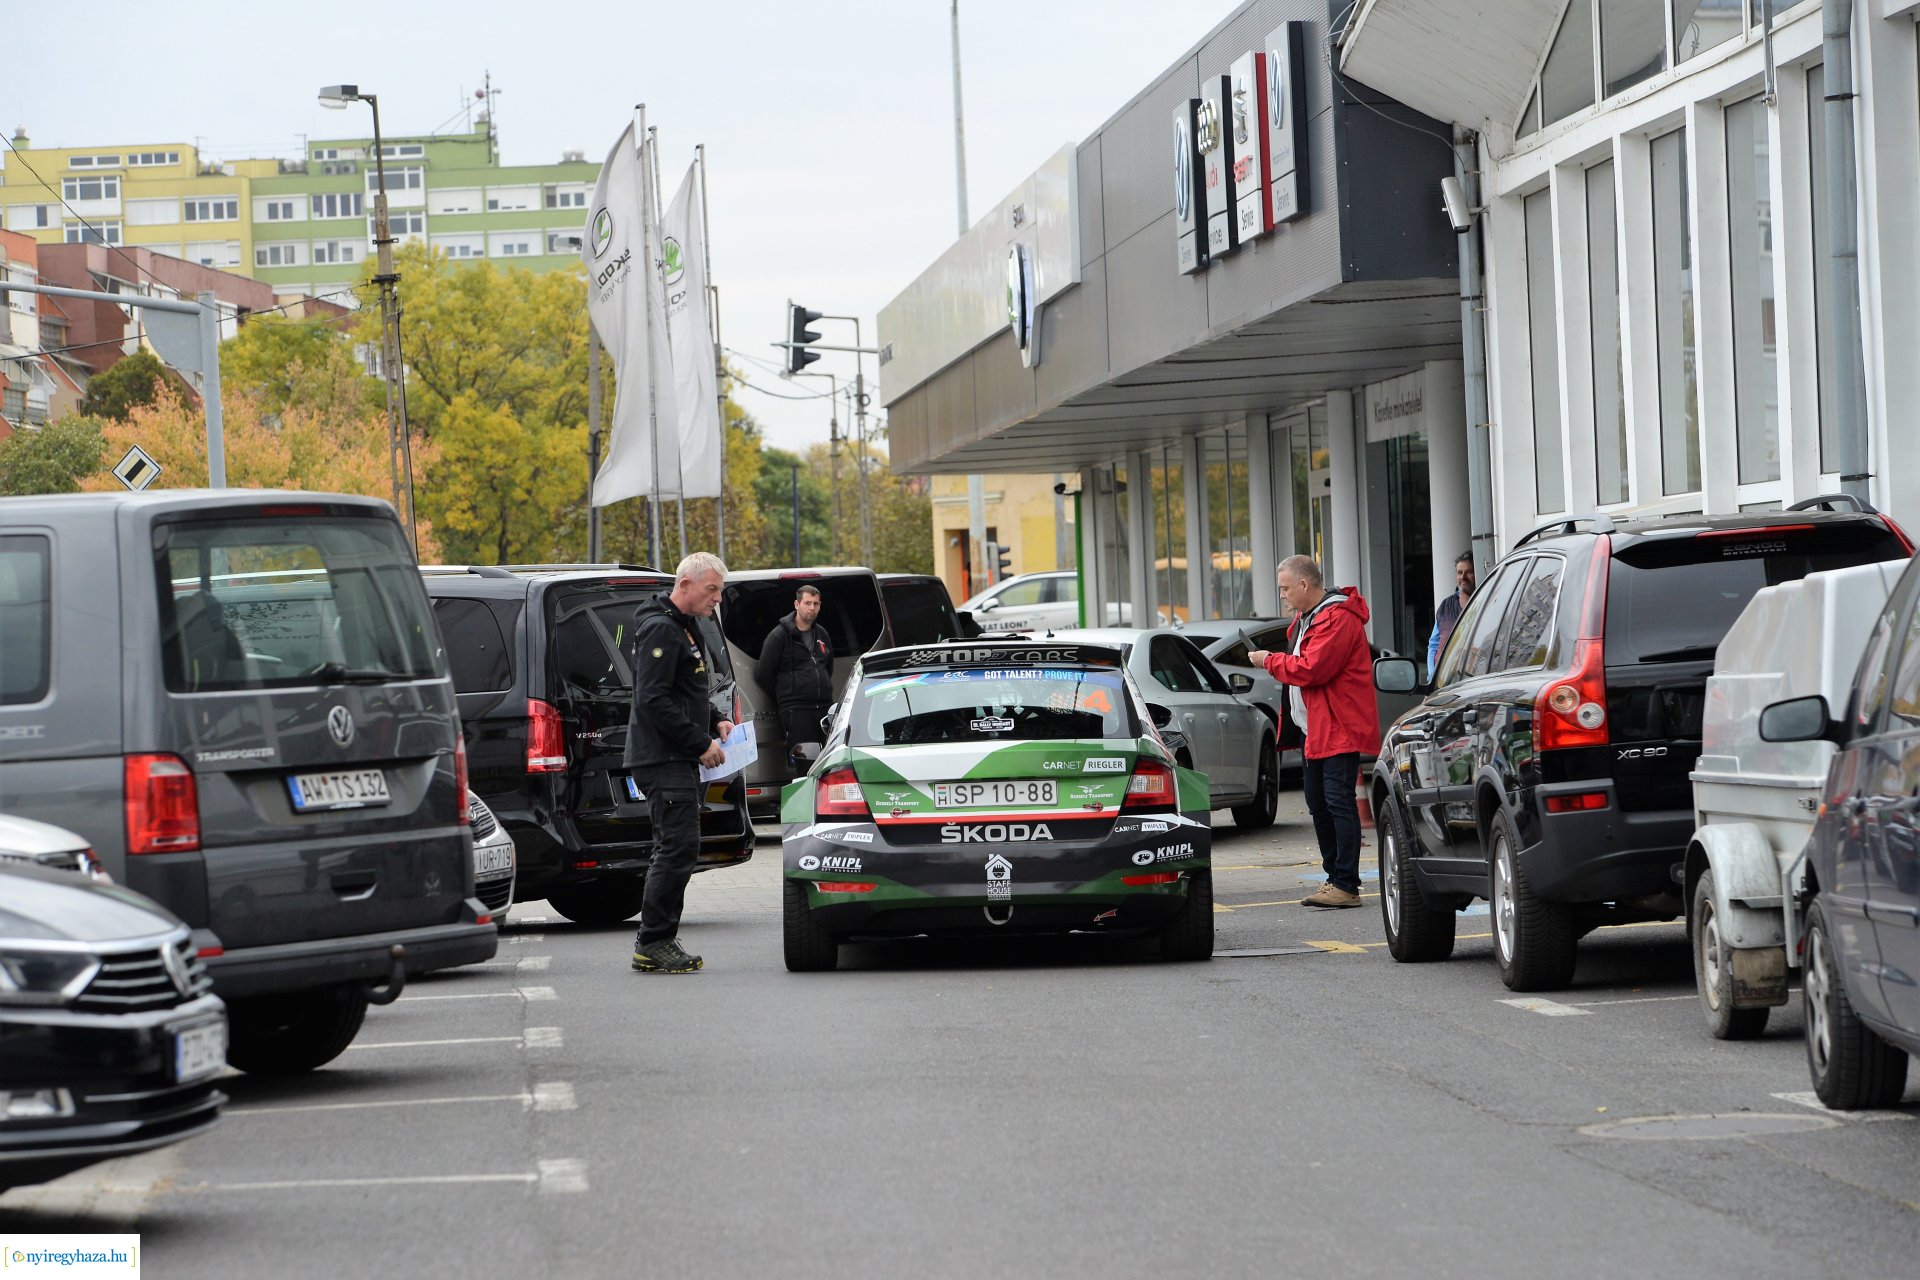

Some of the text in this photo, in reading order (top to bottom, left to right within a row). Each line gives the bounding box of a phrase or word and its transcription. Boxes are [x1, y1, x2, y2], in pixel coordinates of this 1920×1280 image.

[1241, 205, 1254, 231] Service
[1000, 621, 1028, 630] LEON?
[938, 649, 1079, 663] TOP CARS
[984, 671, 1002, 680] GOT
[1004, 670, 1043, 680] TALENT?
[1045, 670, 1073, 681] PROVE
[1084, 690, 1112, 714] 4
[1042, 761, 1123, 770] CARNET RIEGLER
[954, 782, 1054, 805] SP 10-88
[938, 796, 948, 805] H
[940, 821, 1054, 843] ŠKODA
[1115, 824, 1140, 832] CARNET
[1157, 843, 1194, 858] KNIPL
[821, 856, 862, 868] KNIPL
